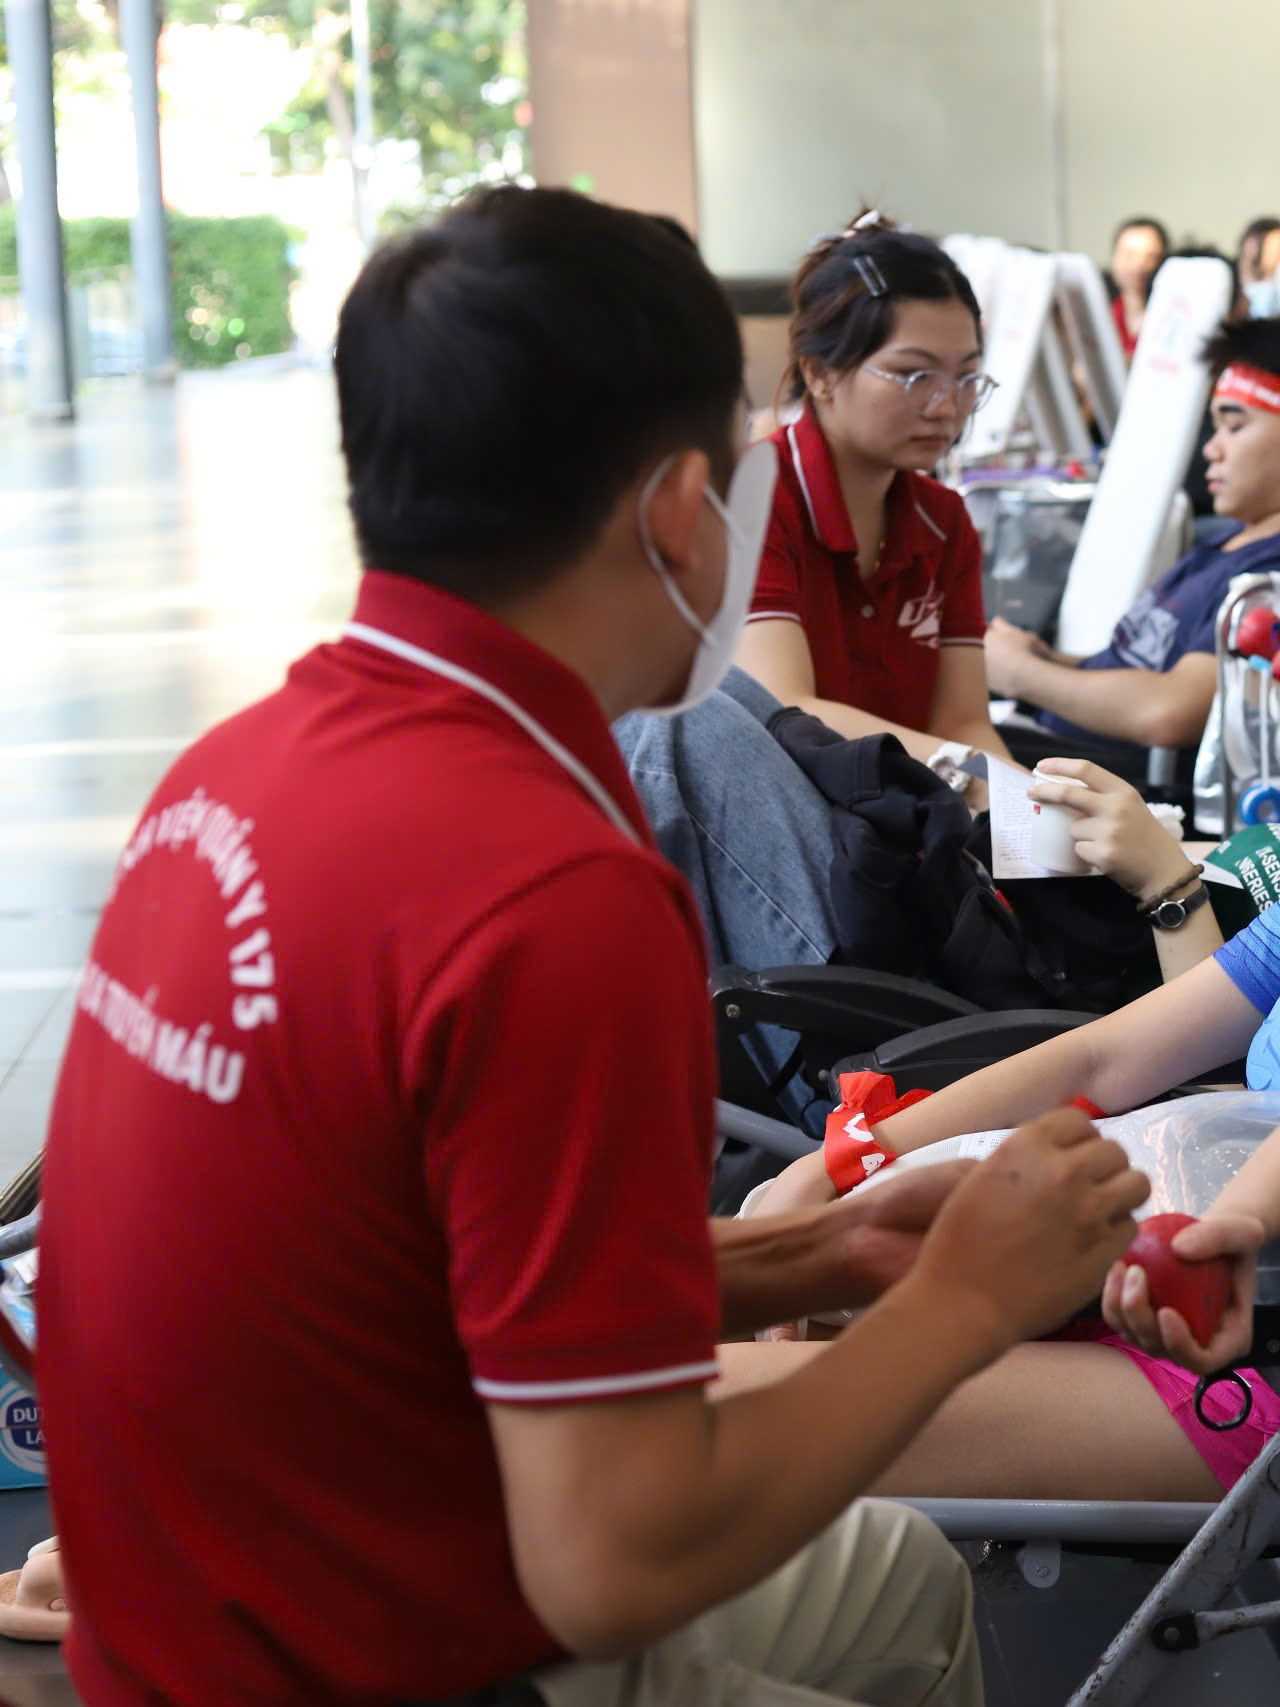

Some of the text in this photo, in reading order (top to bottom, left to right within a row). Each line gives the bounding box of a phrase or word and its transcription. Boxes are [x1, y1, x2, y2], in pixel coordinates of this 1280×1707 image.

[225, 880, 267, 929] Y
[228, 928, 278, 1032] 175
[152, 1021, 246, 1104] MÁU
